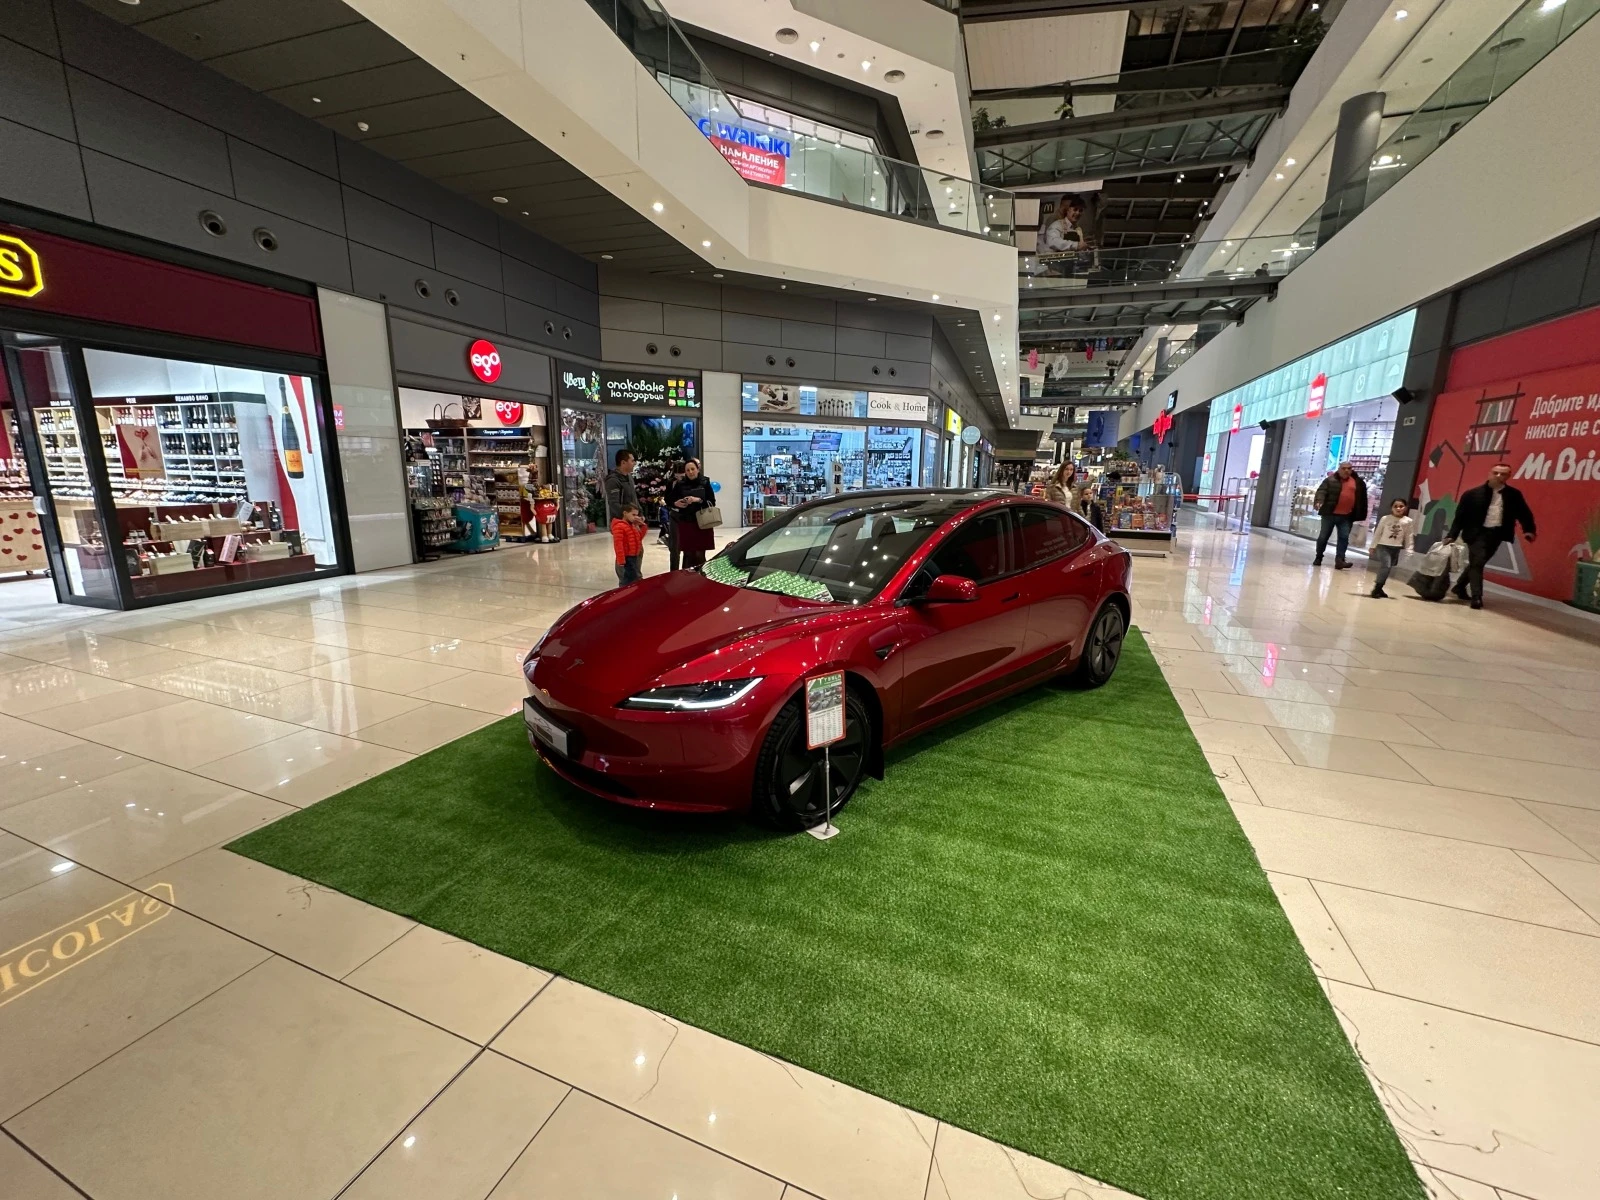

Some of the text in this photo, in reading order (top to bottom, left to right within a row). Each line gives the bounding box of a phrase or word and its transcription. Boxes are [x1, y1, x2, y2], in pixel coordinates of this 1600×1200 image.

[717, 122, 790, 158] waikiki
[720, 144, 780, 169] НАМАЛЕНИЕ
[472, 352, 501, 377] ego
[606, 378, 665, 393] опаковане
[610, 389, 622, 398] на
[870, 399, 926, 412] Cook & Home
[1529, 394, 1584, 419] Добрите
[1524, 422, 1569, 440] никога
[1570, 420, 1589, 436] не
[1512, 452, 1552, 480] Mr
